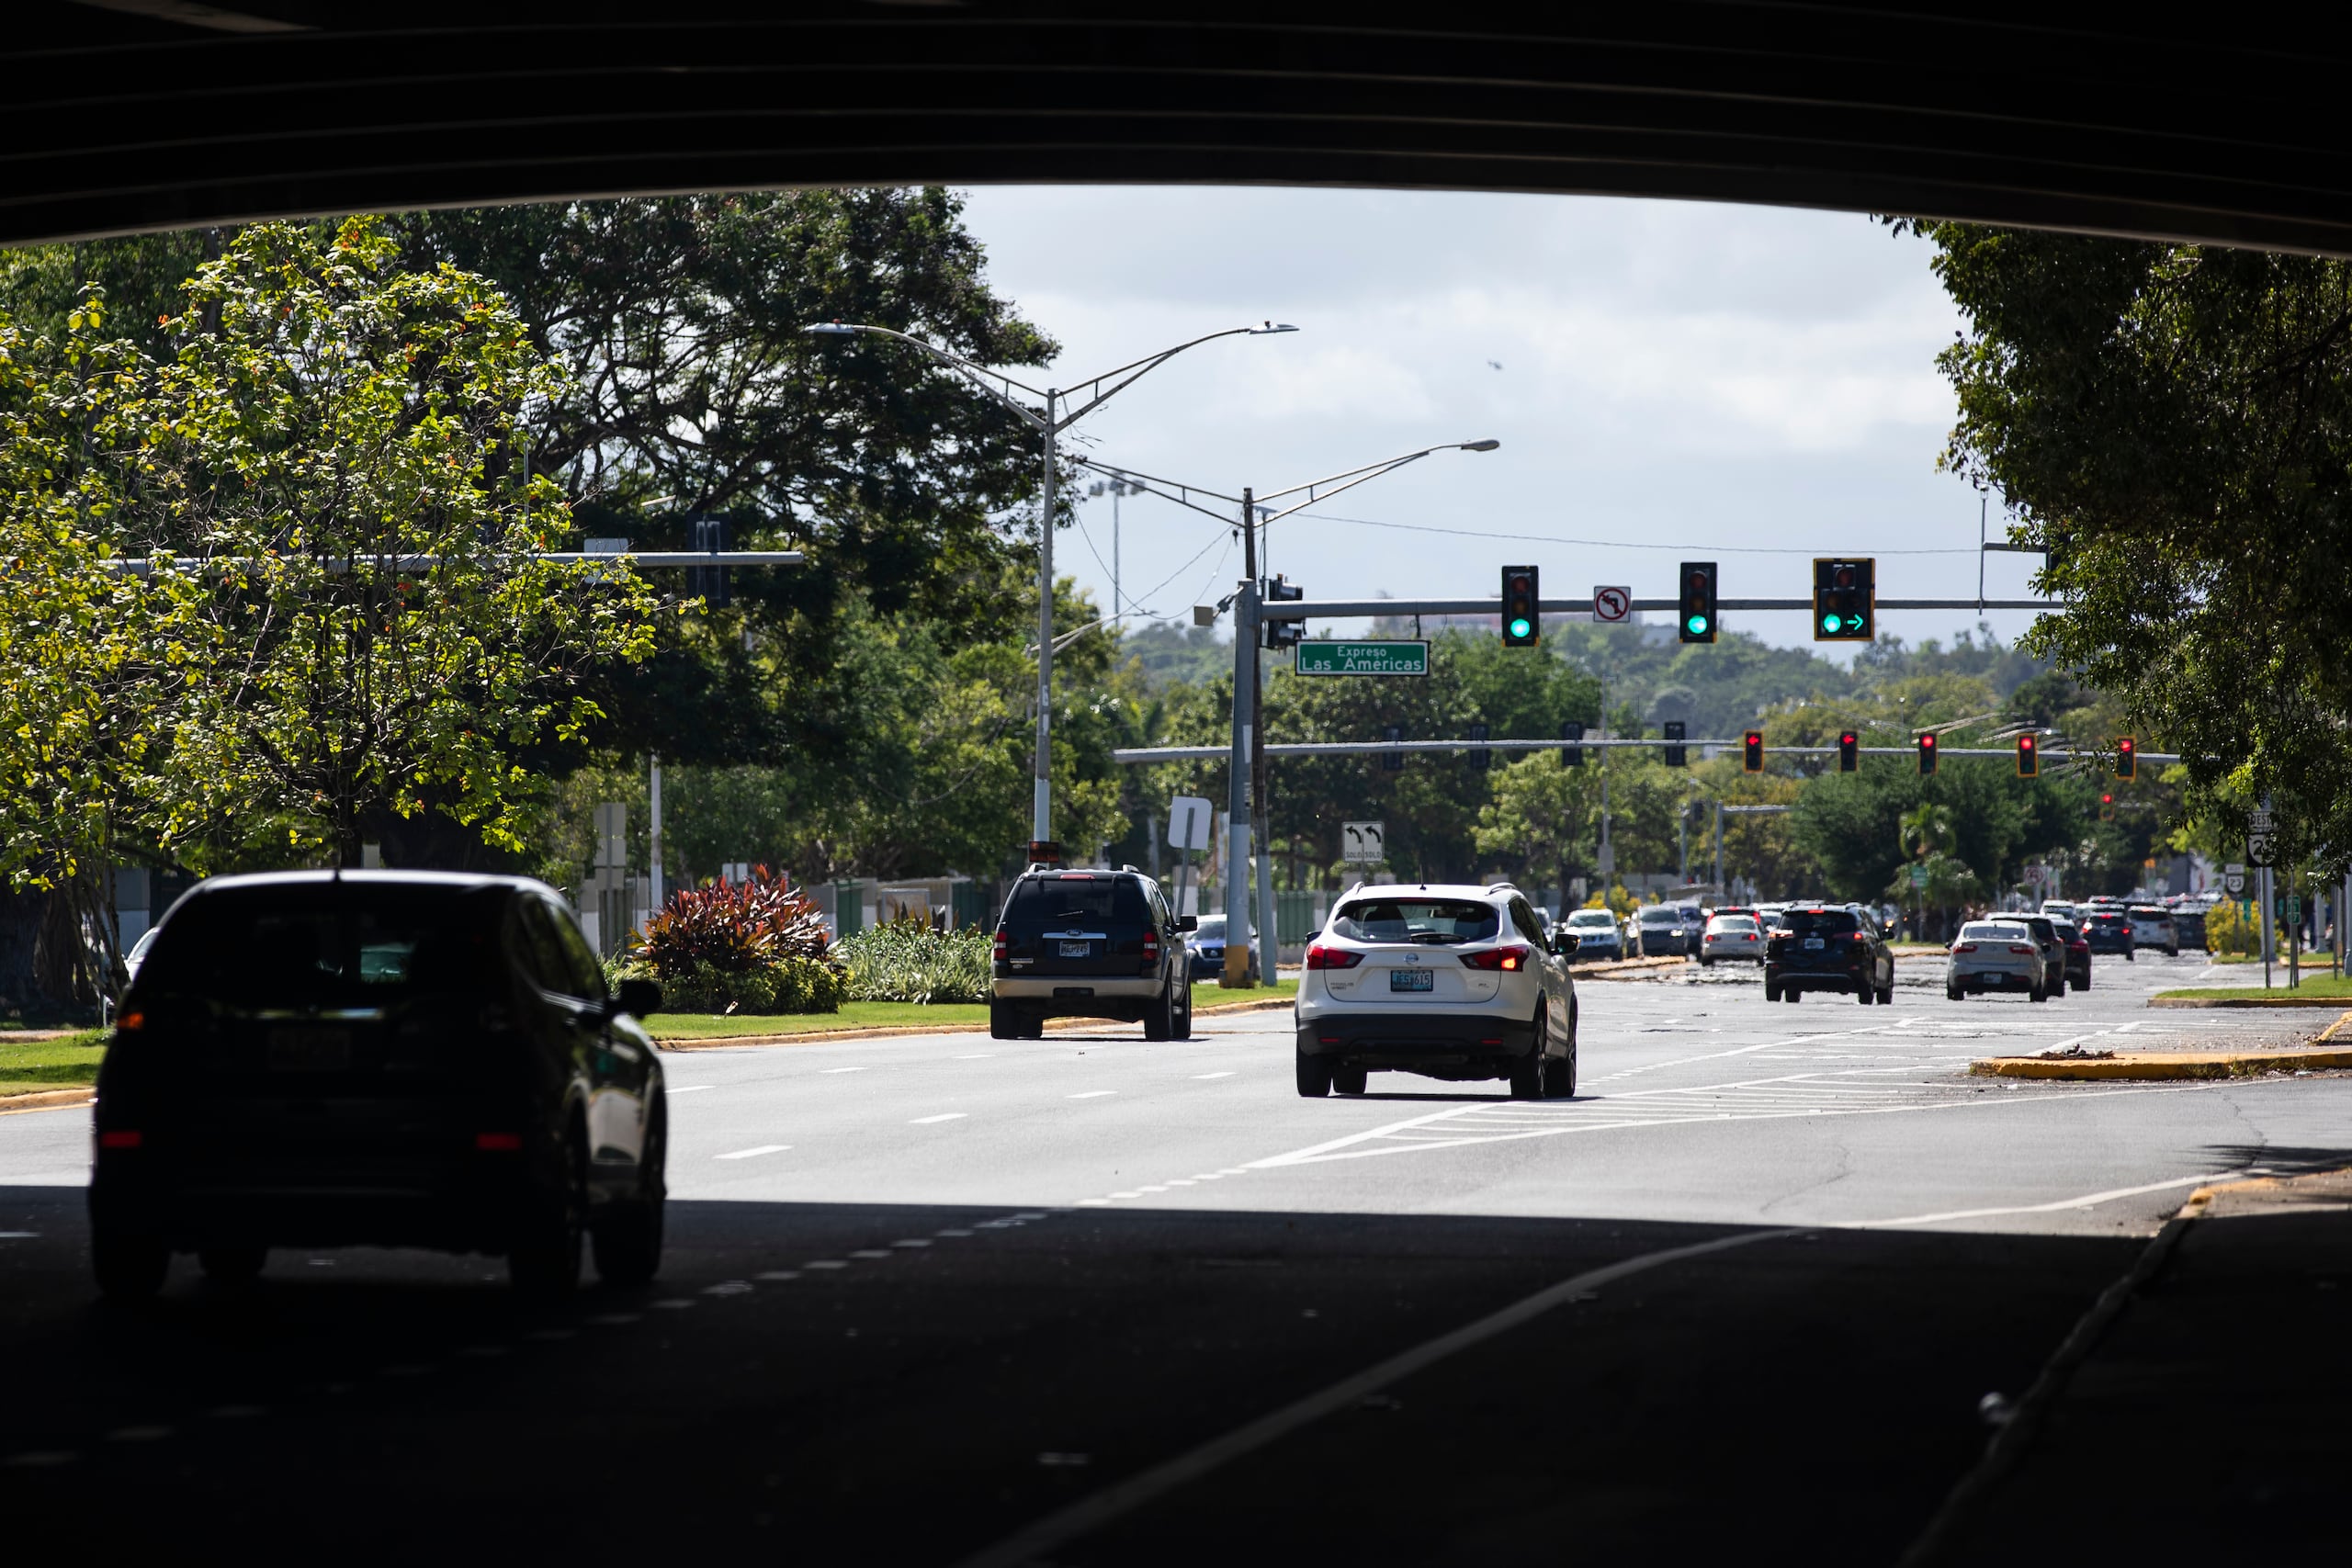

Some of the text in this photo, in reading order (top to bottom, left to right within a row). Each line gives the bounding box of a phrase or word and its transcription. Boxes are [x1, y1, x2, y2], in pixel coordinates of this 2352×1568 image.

[1337, 646, 1386, 660] Expreso
[1302, 657, 1332, 671] Las
[1415, 975, 1430, 986] 615
